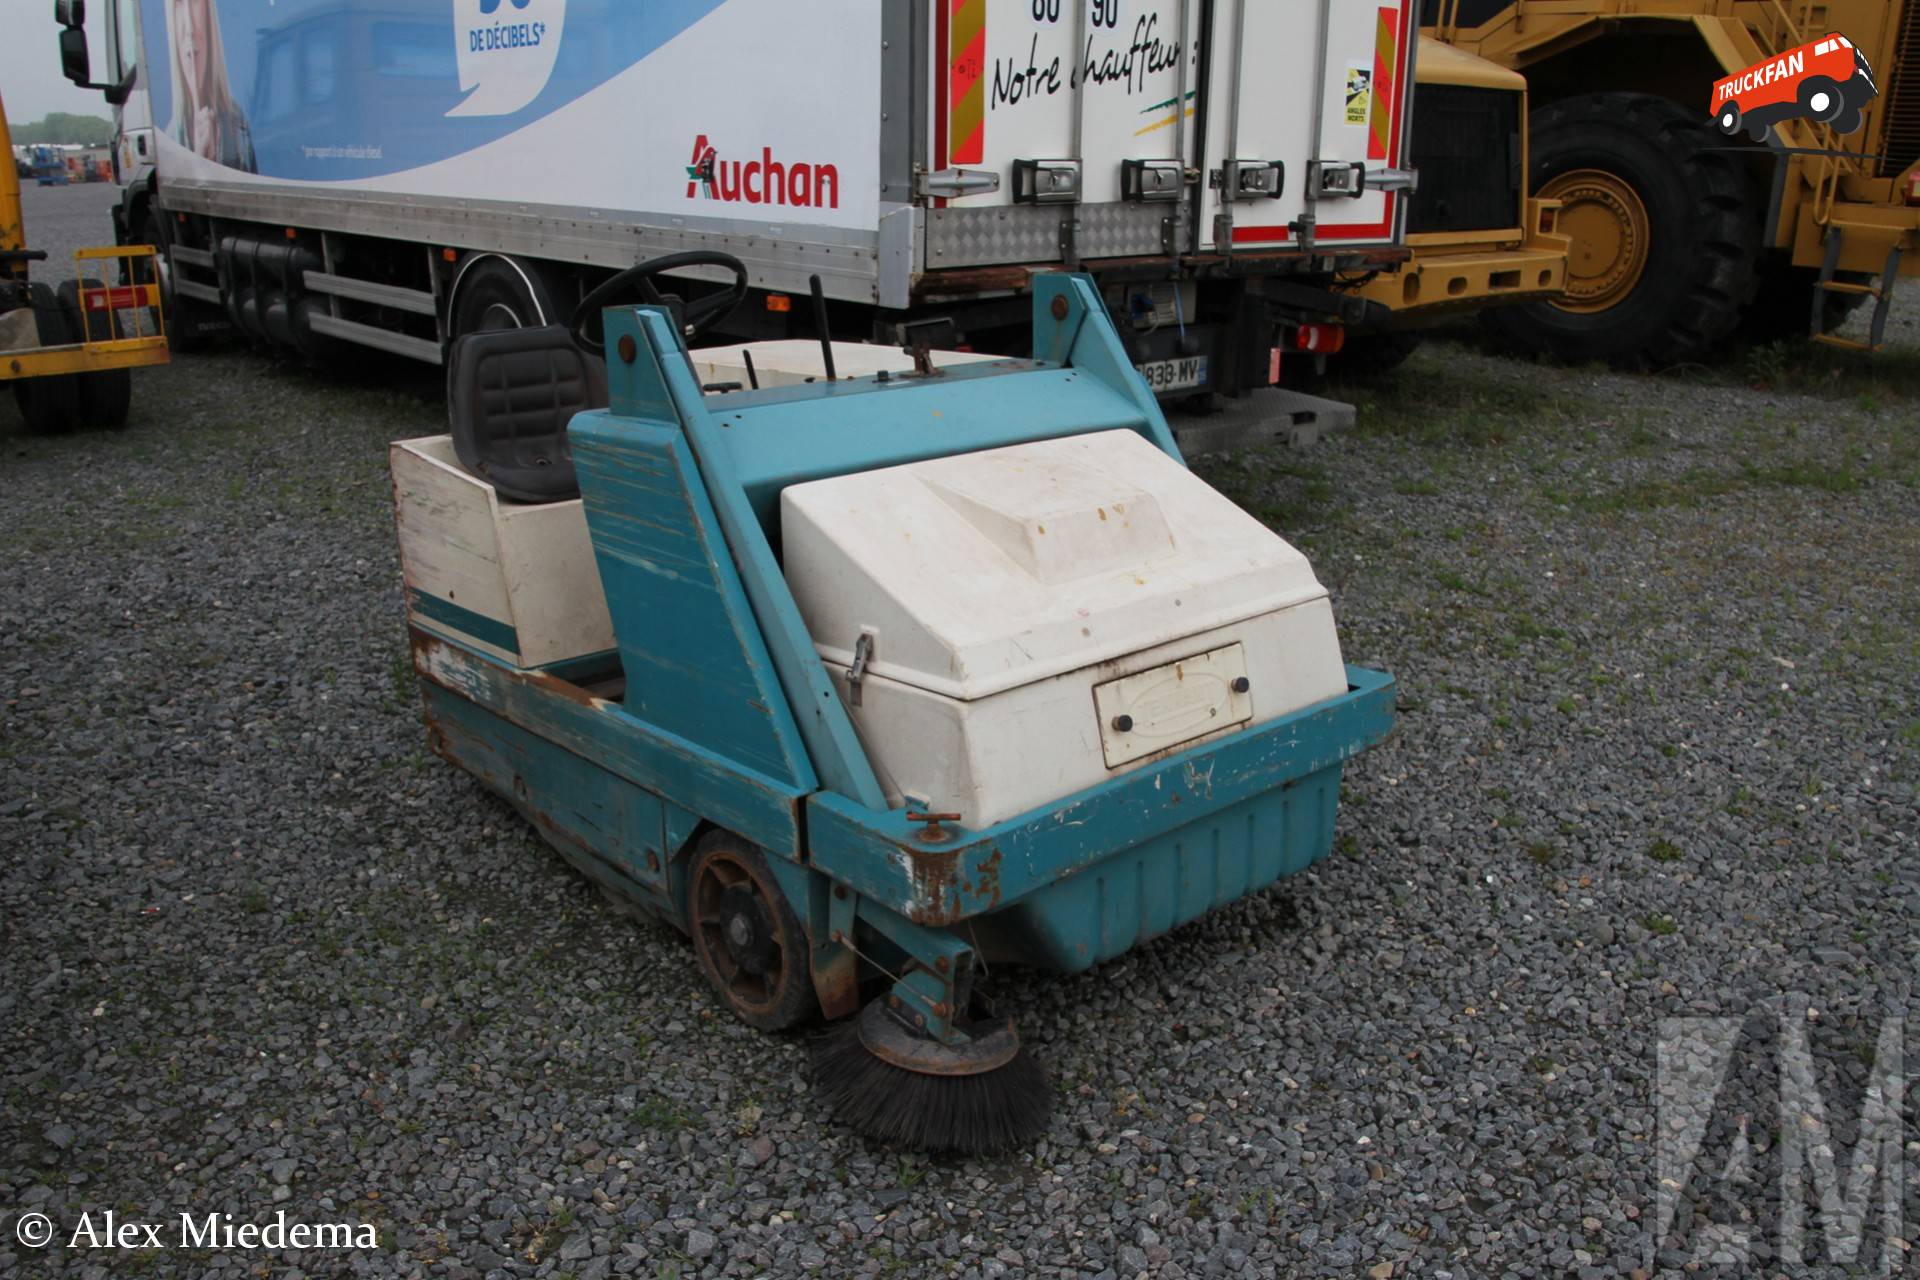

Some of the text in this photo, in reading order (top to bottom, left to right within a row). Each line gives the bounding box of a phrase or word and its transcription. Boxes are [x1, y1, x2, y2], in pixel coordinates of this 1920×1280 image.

[469, 29, 485, 52] DE
[992, 33, 1061, 110] Notre
[686, 135, 838, 209] Auchan
[1138, 359, 1198, 386] 833-MV
